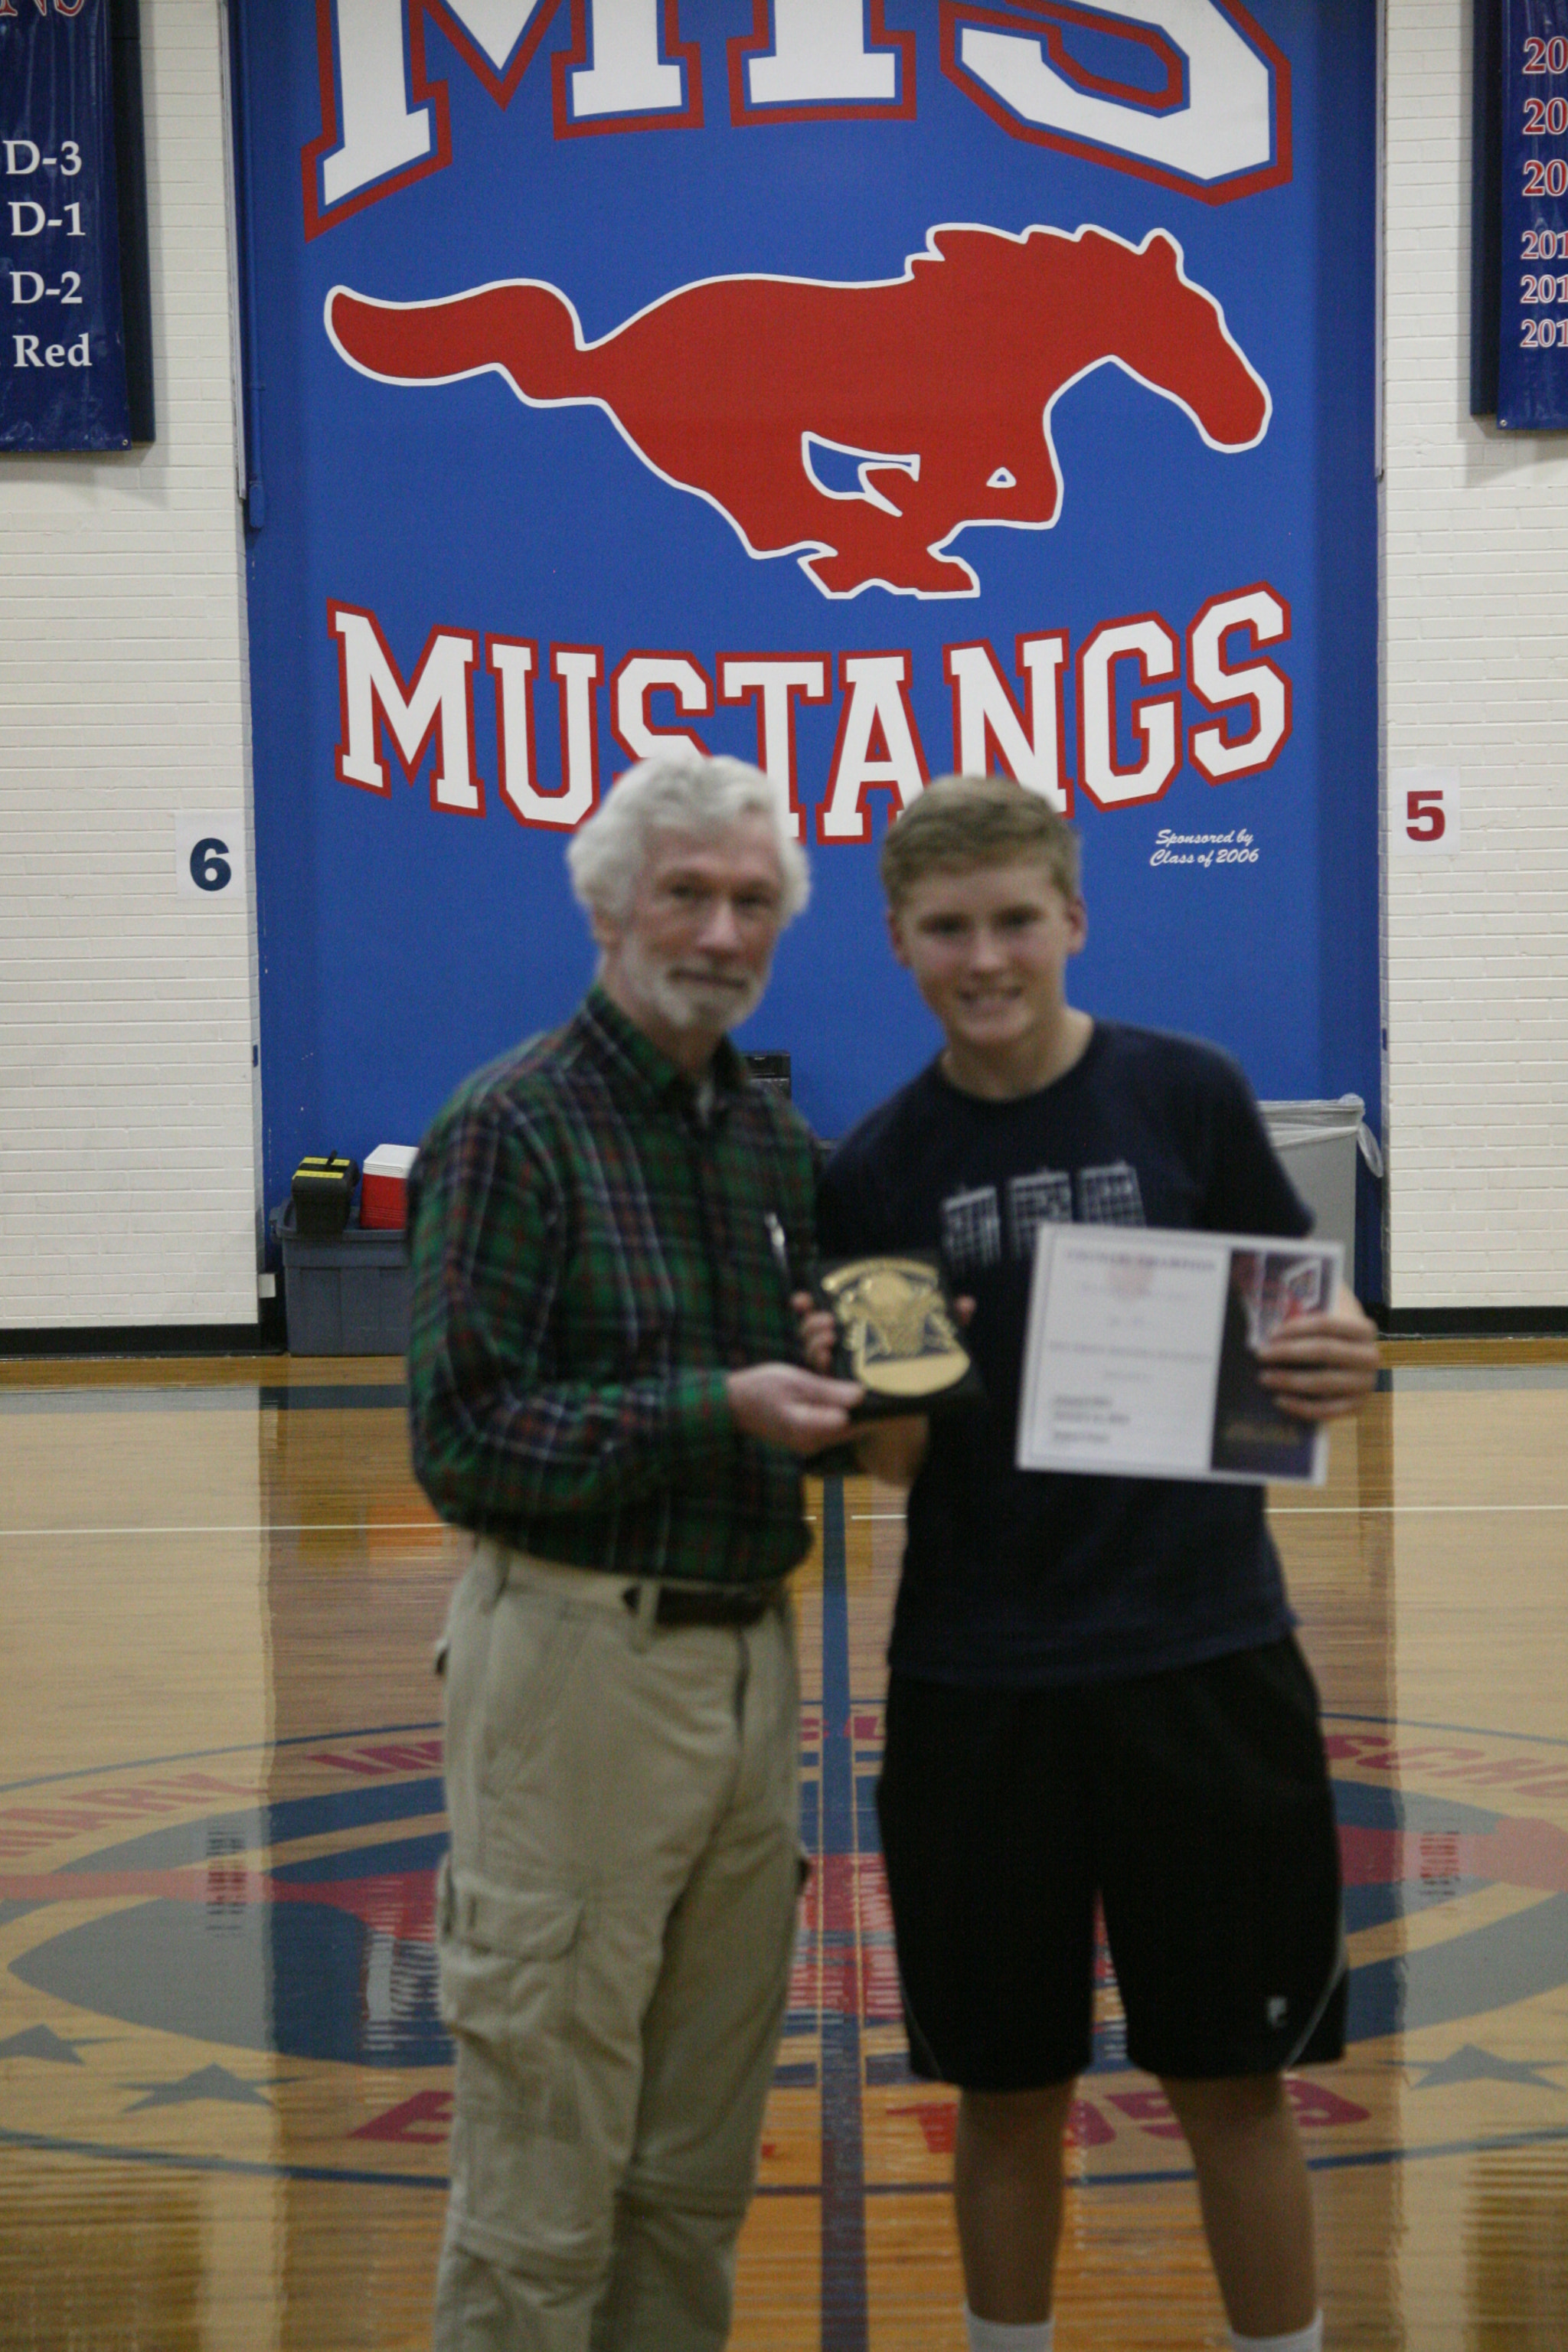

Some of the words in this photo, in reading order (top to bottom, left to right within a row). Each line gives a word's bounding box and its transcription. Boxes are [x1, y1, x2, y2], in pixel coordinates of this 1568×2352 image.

[3, 140, 82, 175] D-3
[8, 202, 86, 236] D-1
[9, 271, 83, 304] D-2
[12, 332, 92, 368] Red
[327, 580, 1292, 844] MUSTANGS
[1406, 790, 1446, 842] 5
[1155, 828, 1235, 848] Sponsored
[1236, 828, 1254, 846] by
[190, 838, 232, 891] 6
[1150, 849, 1194, 866] Class
[1197, 850, 1214, 867] of
[1216, 848, 1259, 863] 2006
